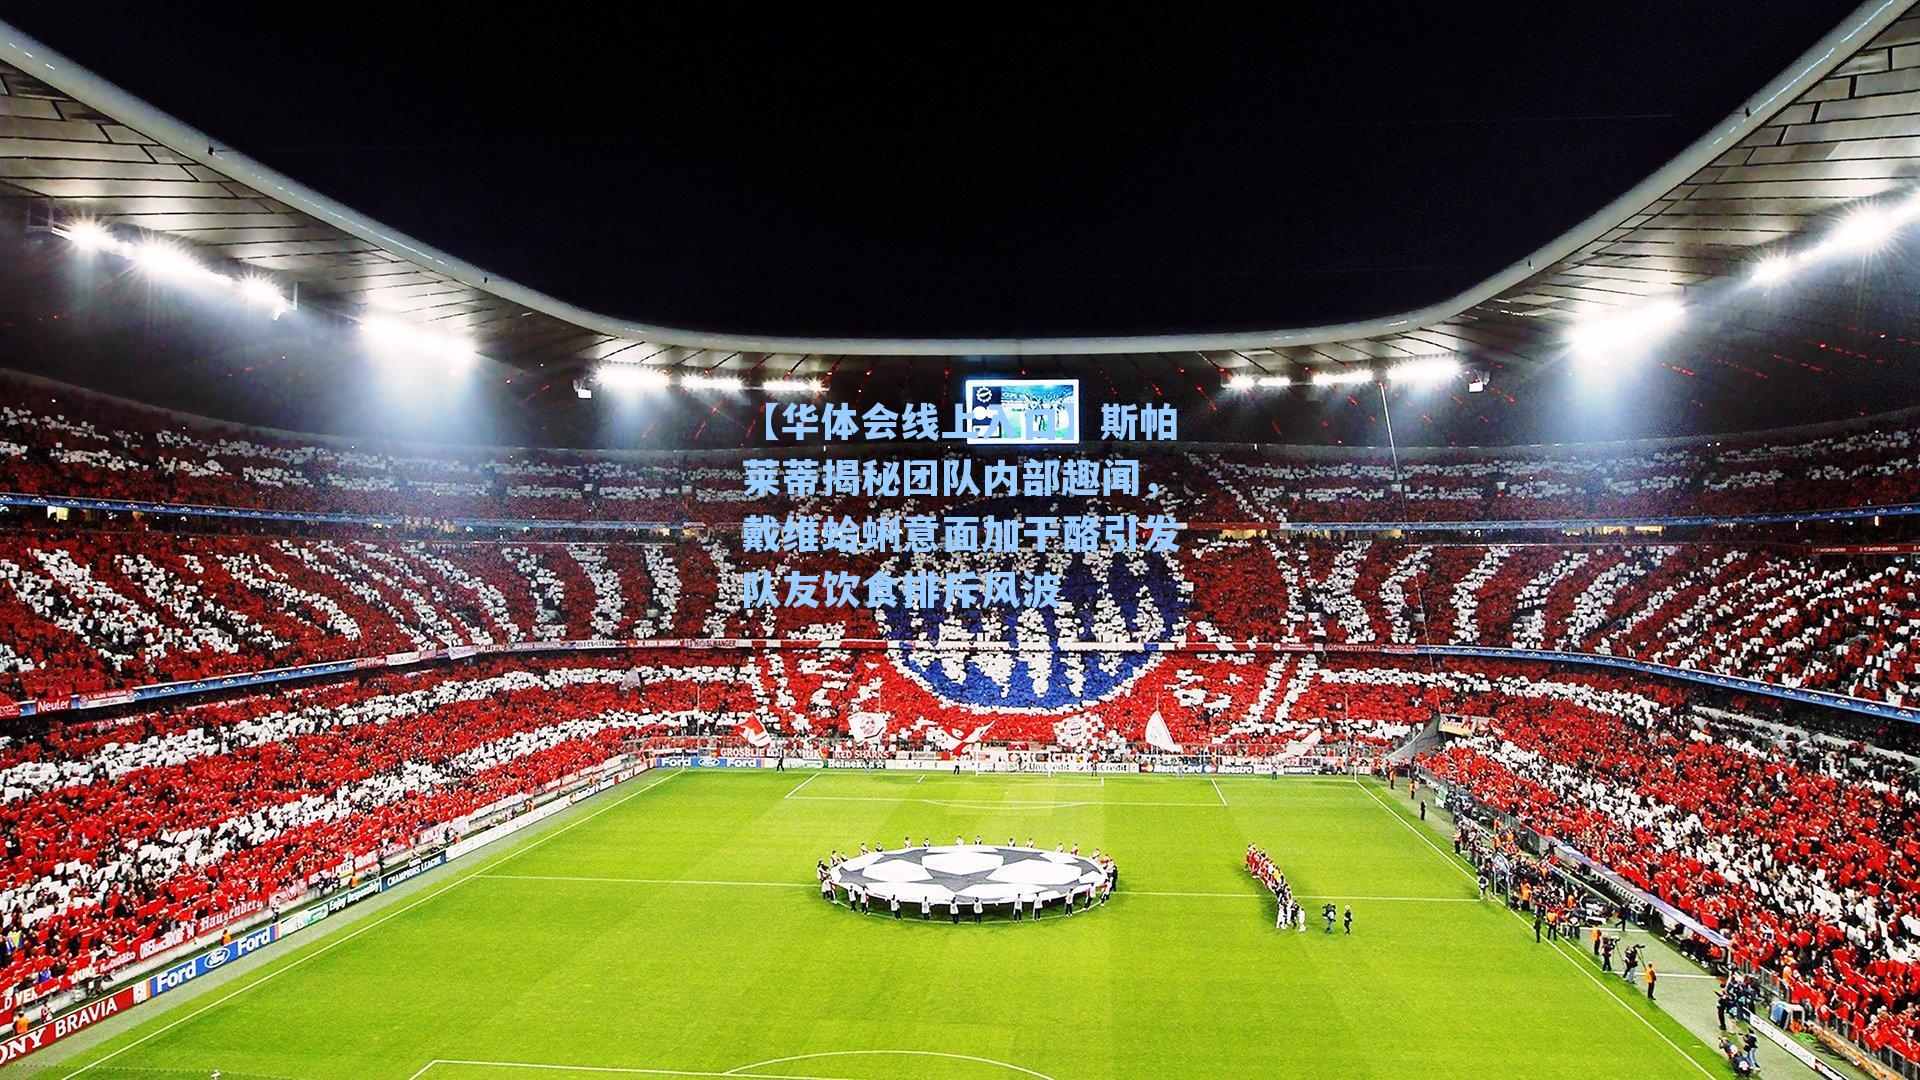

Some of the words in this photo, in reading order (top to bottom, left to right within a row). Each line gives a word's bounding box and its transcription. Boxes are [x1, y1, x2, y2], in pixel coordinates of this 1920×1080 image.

[661, 757, 691, 767] Ford
[726, 758, 757, 767] Ford
[387, 865, 421, 887] CHAMPIONS
[421, 855, 442, 882] LEAGUE
[328, 895, 347, 911] Enjoy
[237, 926, 271, 956] Ford
[155, 960, 197, 992] Ford
[55, 997, 118, 1038] BRAVIA
